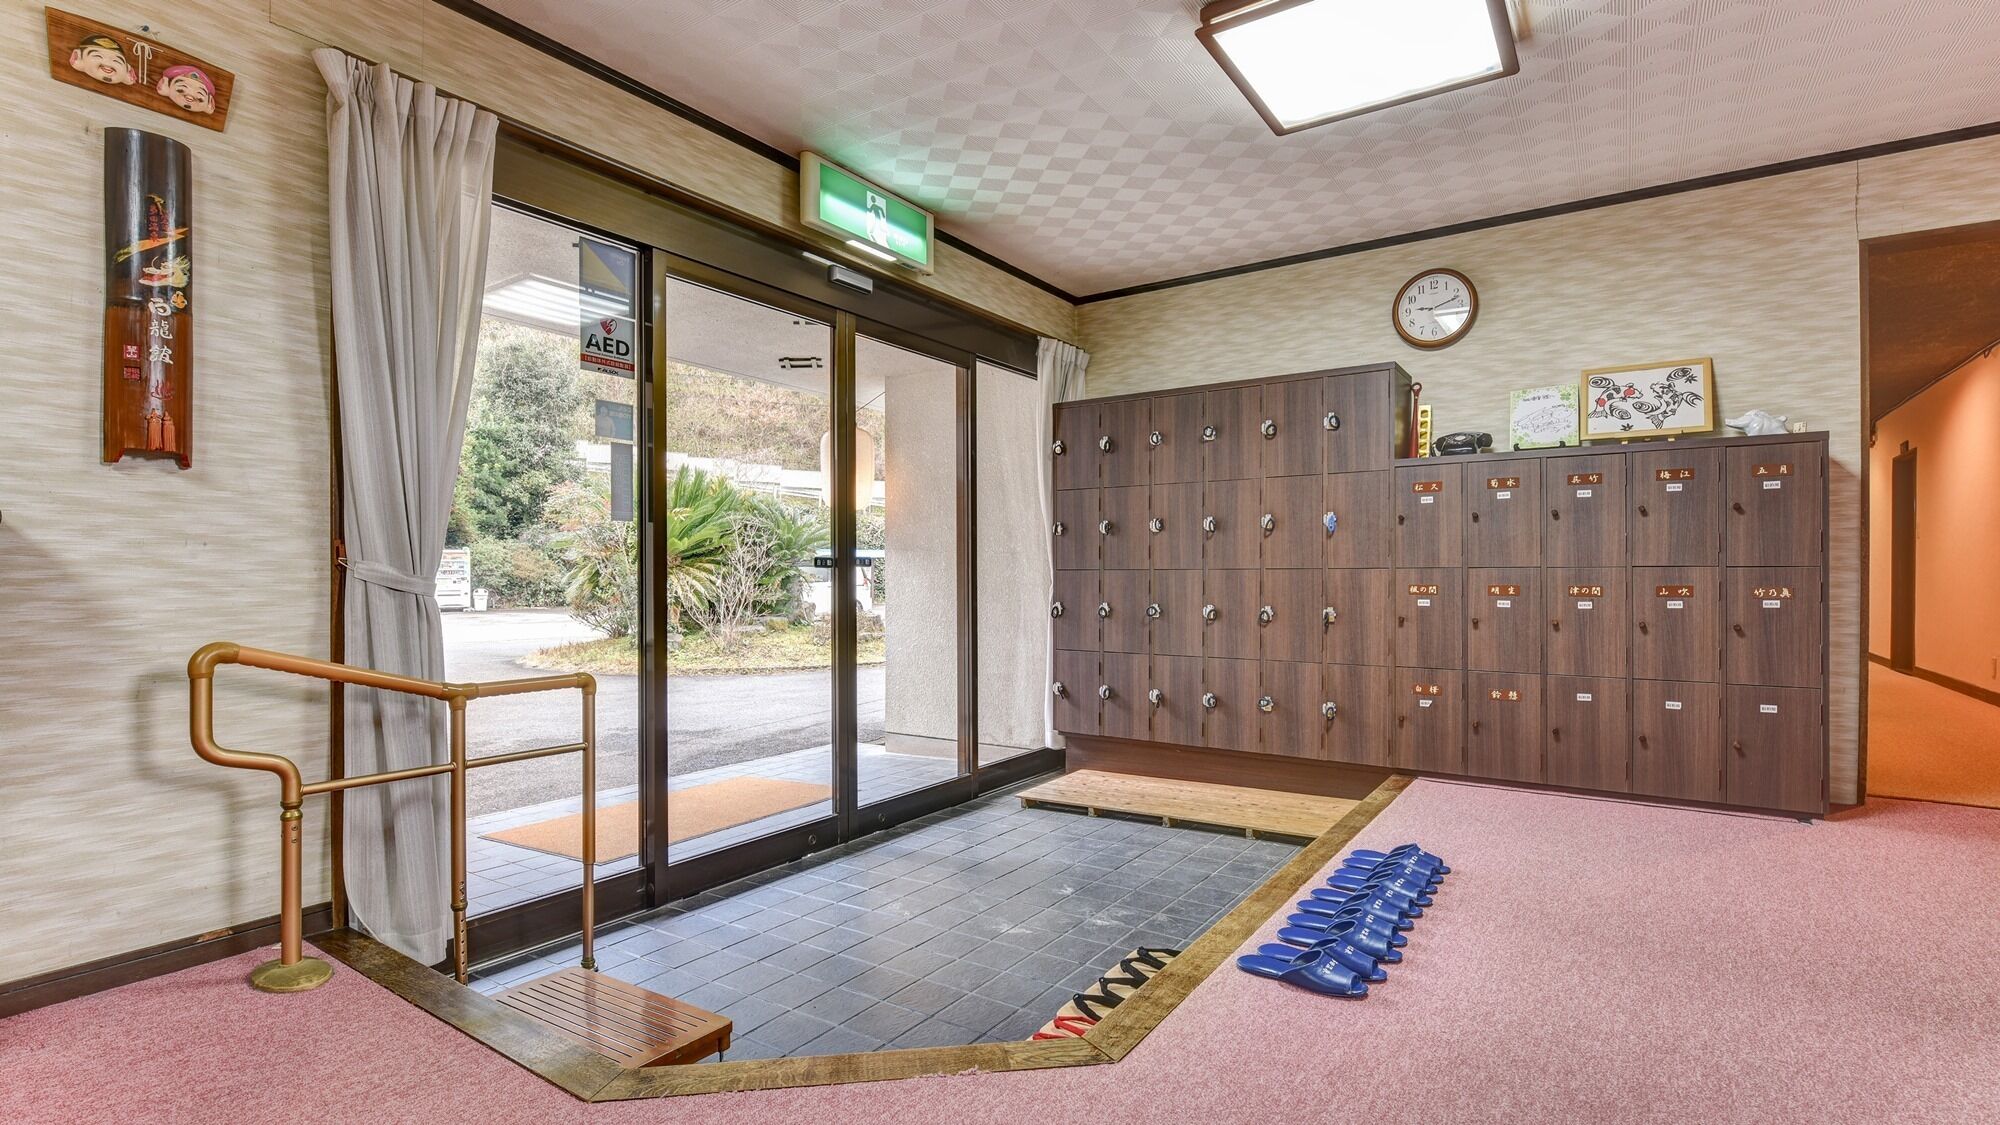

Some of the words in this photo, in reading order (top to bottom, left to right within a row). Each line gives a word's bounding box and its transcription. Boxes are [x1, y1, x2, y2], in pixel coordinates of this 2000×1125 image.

[1418, 285, 1425, 295] 11
[1430, 280, 1439, 290] 12
[1444, 281, 1448, 291] 1
[1453, 288, 1460, 298] 2
[1408, 295, 1416, 304] 10
[1405, 308, 1411, 317] 9
[1408, 318, 1415, 328] 8
[1419, 326, 1425, 335] 7
[1431, 327, 1438, 337] 6
[585, 333, 630, 357] AED
[1757, 464, 1787, 475] 五月
[1660, 587, 1690, 596] 山吹
